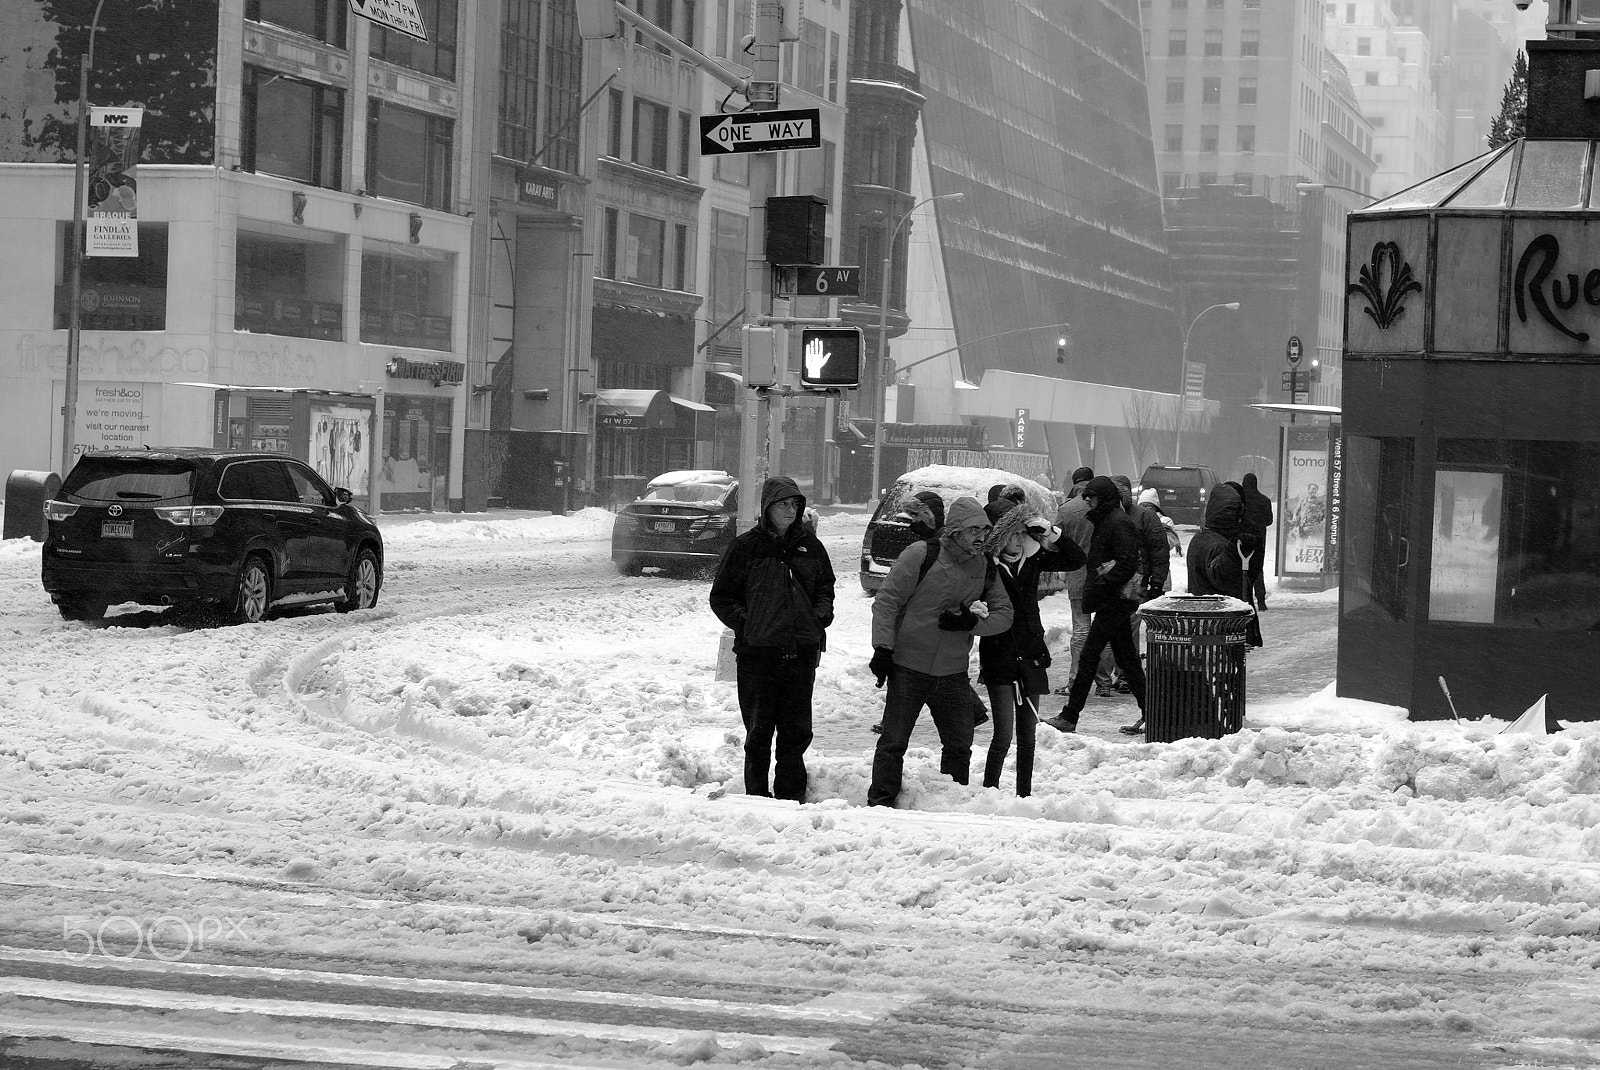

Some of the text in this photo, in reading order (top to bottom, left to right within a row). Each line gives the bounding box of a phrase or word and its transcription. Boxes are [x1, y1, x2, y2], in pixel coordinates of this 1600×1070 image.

[369, 5, 424, 35] MON THRU FRI
[103, 114, 129, 124] NYC
[719, 121, 804, 142] ONE WAY
[93, 211, 131, 219] BRAQUE
[94, 225, 131, 233] FINDLAY
[815, 270, 850, 293] 6 AV
[1514, 233, 1600, 342] Rue
[103, 295, 141, 303] JOHNSON
[95, 386, 141, 398] fresh&co
[86, 408, 151, 420] we're moving...
[86, 421, 149, 432] visit our nearest
[1017, 408, 1026, 443] PARK
[101, 432, 134, 442] location
[890, 435, 969, 445] American HEALTH BAR
[1334, 437, 1342, 458] West
[1333, 459, 1342, 470] 57
[1332, 471, 1342, 497] Street
[1330, 513, 1340, 545] Avenue
